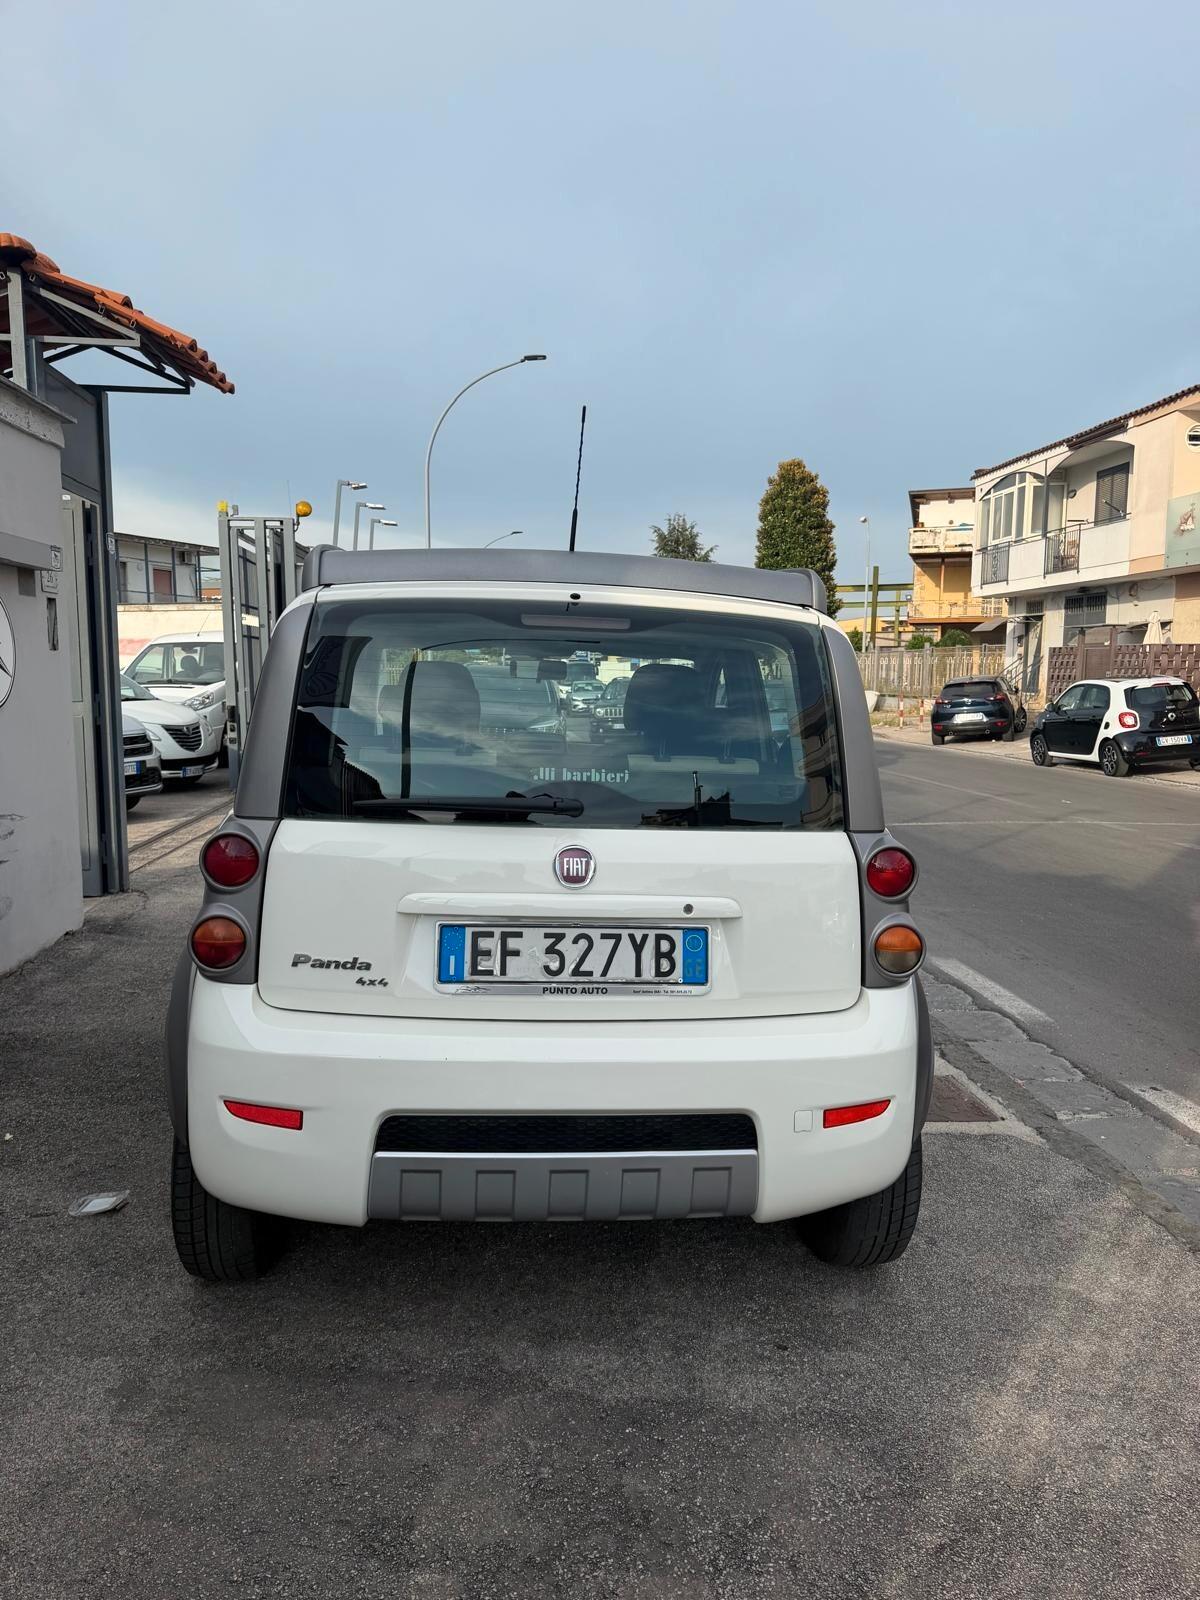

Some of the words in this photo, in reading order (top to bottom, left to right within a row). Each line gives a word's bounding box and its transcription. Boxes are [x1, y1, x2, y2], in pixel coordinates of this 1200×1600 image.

[562, 768, 630, 783] barbieri
[563, 857, 588, 877] FIAT
[291, 953, 373, 971] Panda
[470, 931, 524, 977] EF
[543, 932, 677, 978] 327YB
[355, 976, 389, 987] 4x4
[542, 987, 578, 995] PUNTO
[580, 987, 608, 995] AUTO
